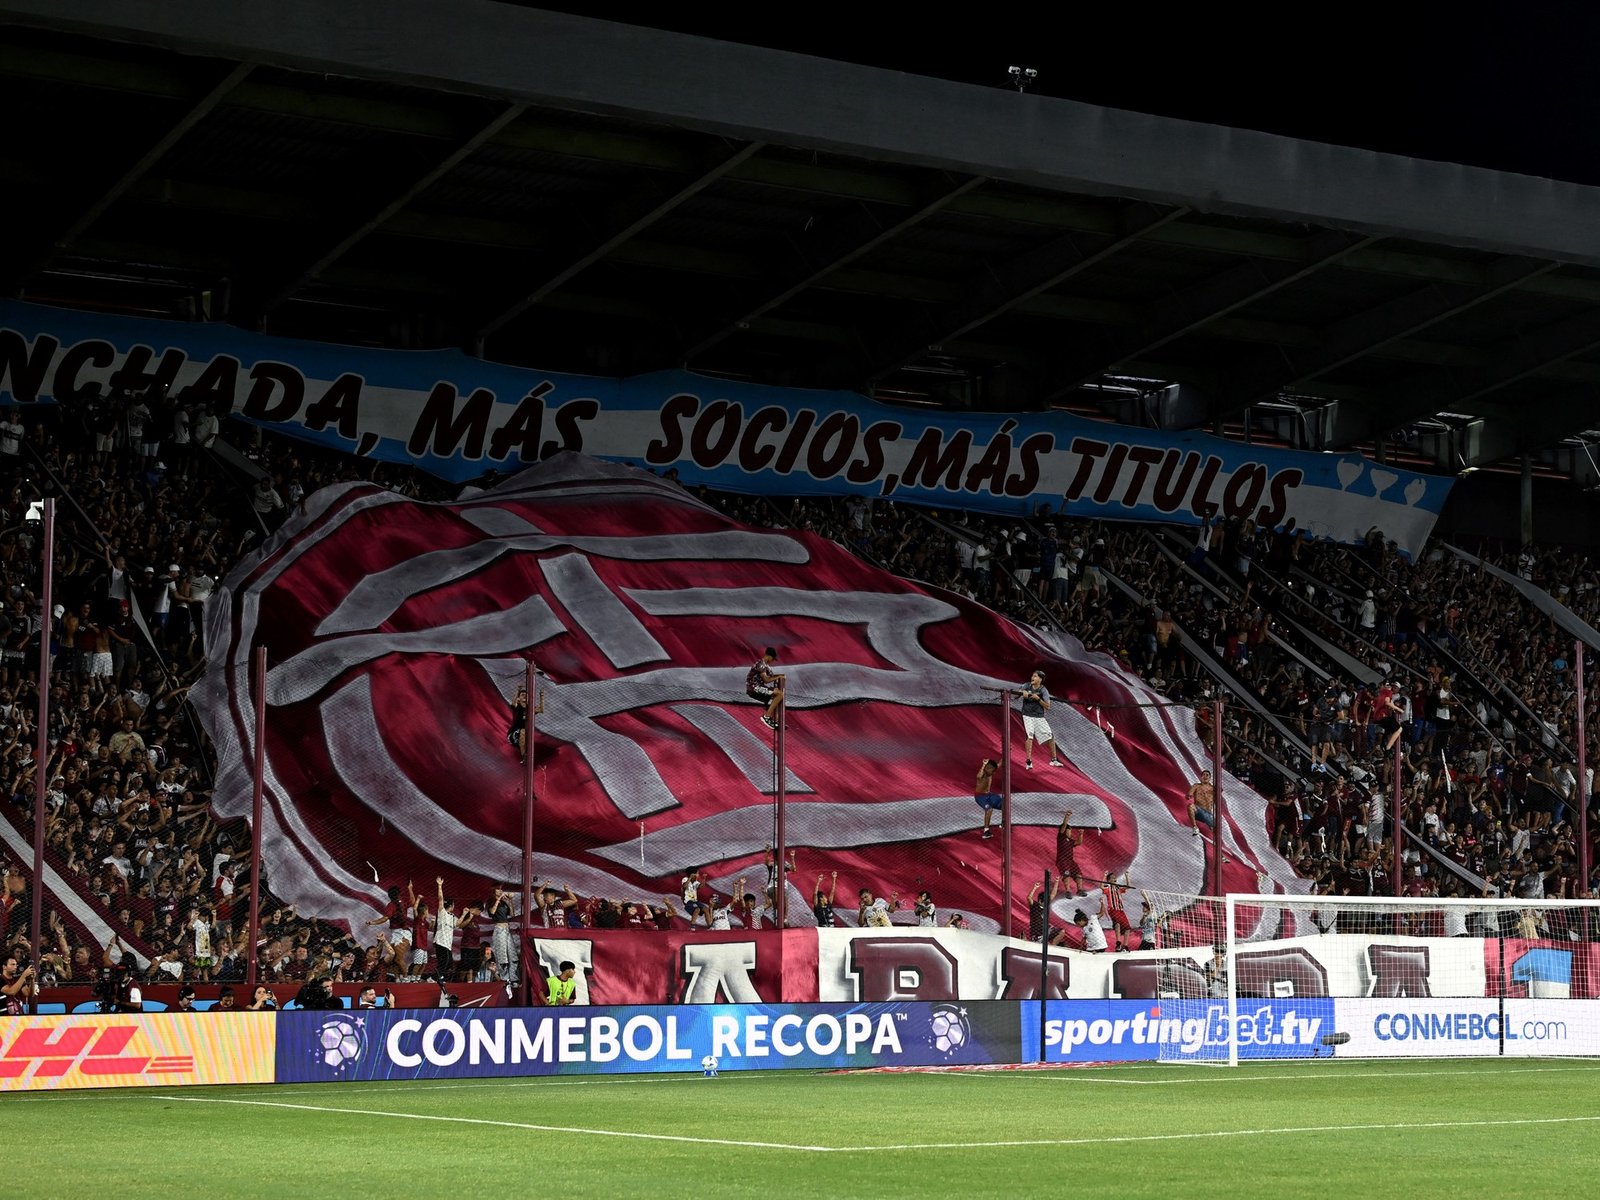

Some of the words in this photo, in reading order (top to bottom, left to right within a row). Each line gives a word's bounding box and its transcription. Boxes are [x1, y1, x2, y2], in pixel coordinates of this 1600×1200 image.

[407, 380, 600, 463] MÁS
[645, 393, 902, 496] SOCIOS,
[901, 418, 1056, 497] MÁS
[0, 1025, 151, 1077] HL
[387, 1014, 692, 1067] CONMEBOL
[1045, 1005, 1321, 1054] sportingbet.tv
[1374, 1013, 1566, 1041] CONMEBOL.com
